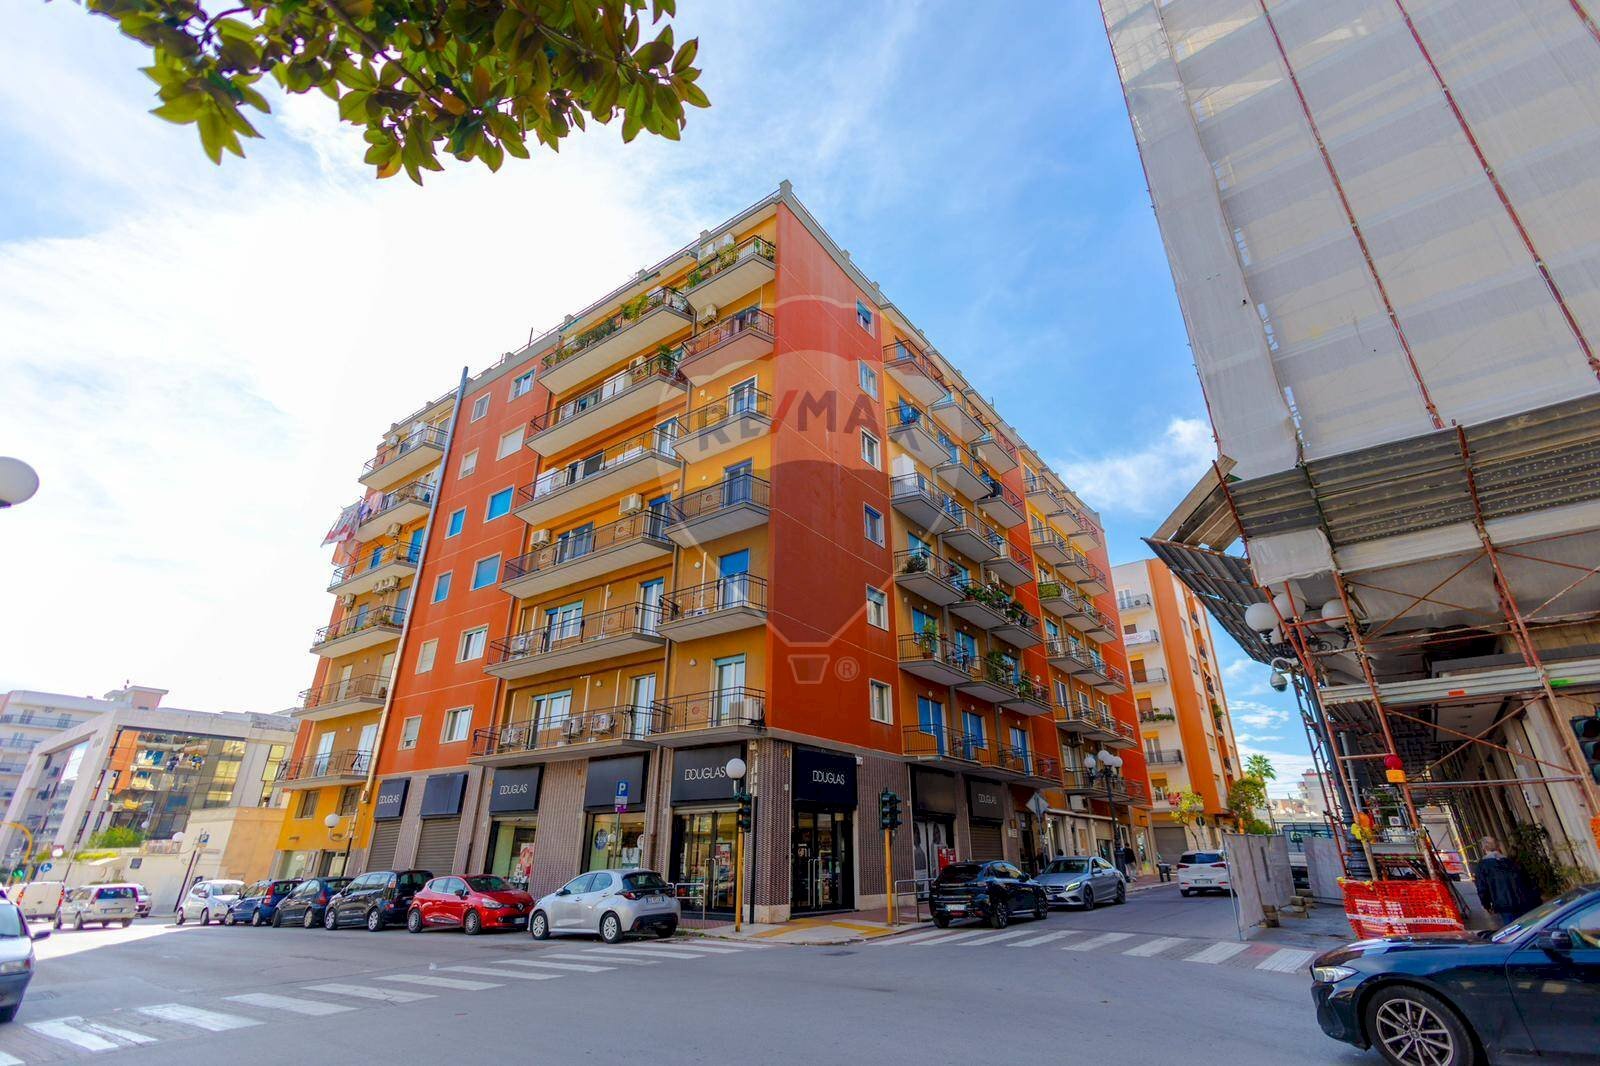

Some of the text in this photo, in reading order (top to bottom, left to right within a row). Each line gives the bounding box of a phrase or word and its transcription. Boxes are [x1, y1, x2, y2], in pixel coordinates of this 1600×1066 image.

[684, 766, 726, 781] DOUGLAS
[812, 770, 845, 785] DOUGLAS
[499, 783, 528, 795] DOUGLAS
[618, 782, 627, 795] P
[378, 793, 400, 805] DOUGLAS
